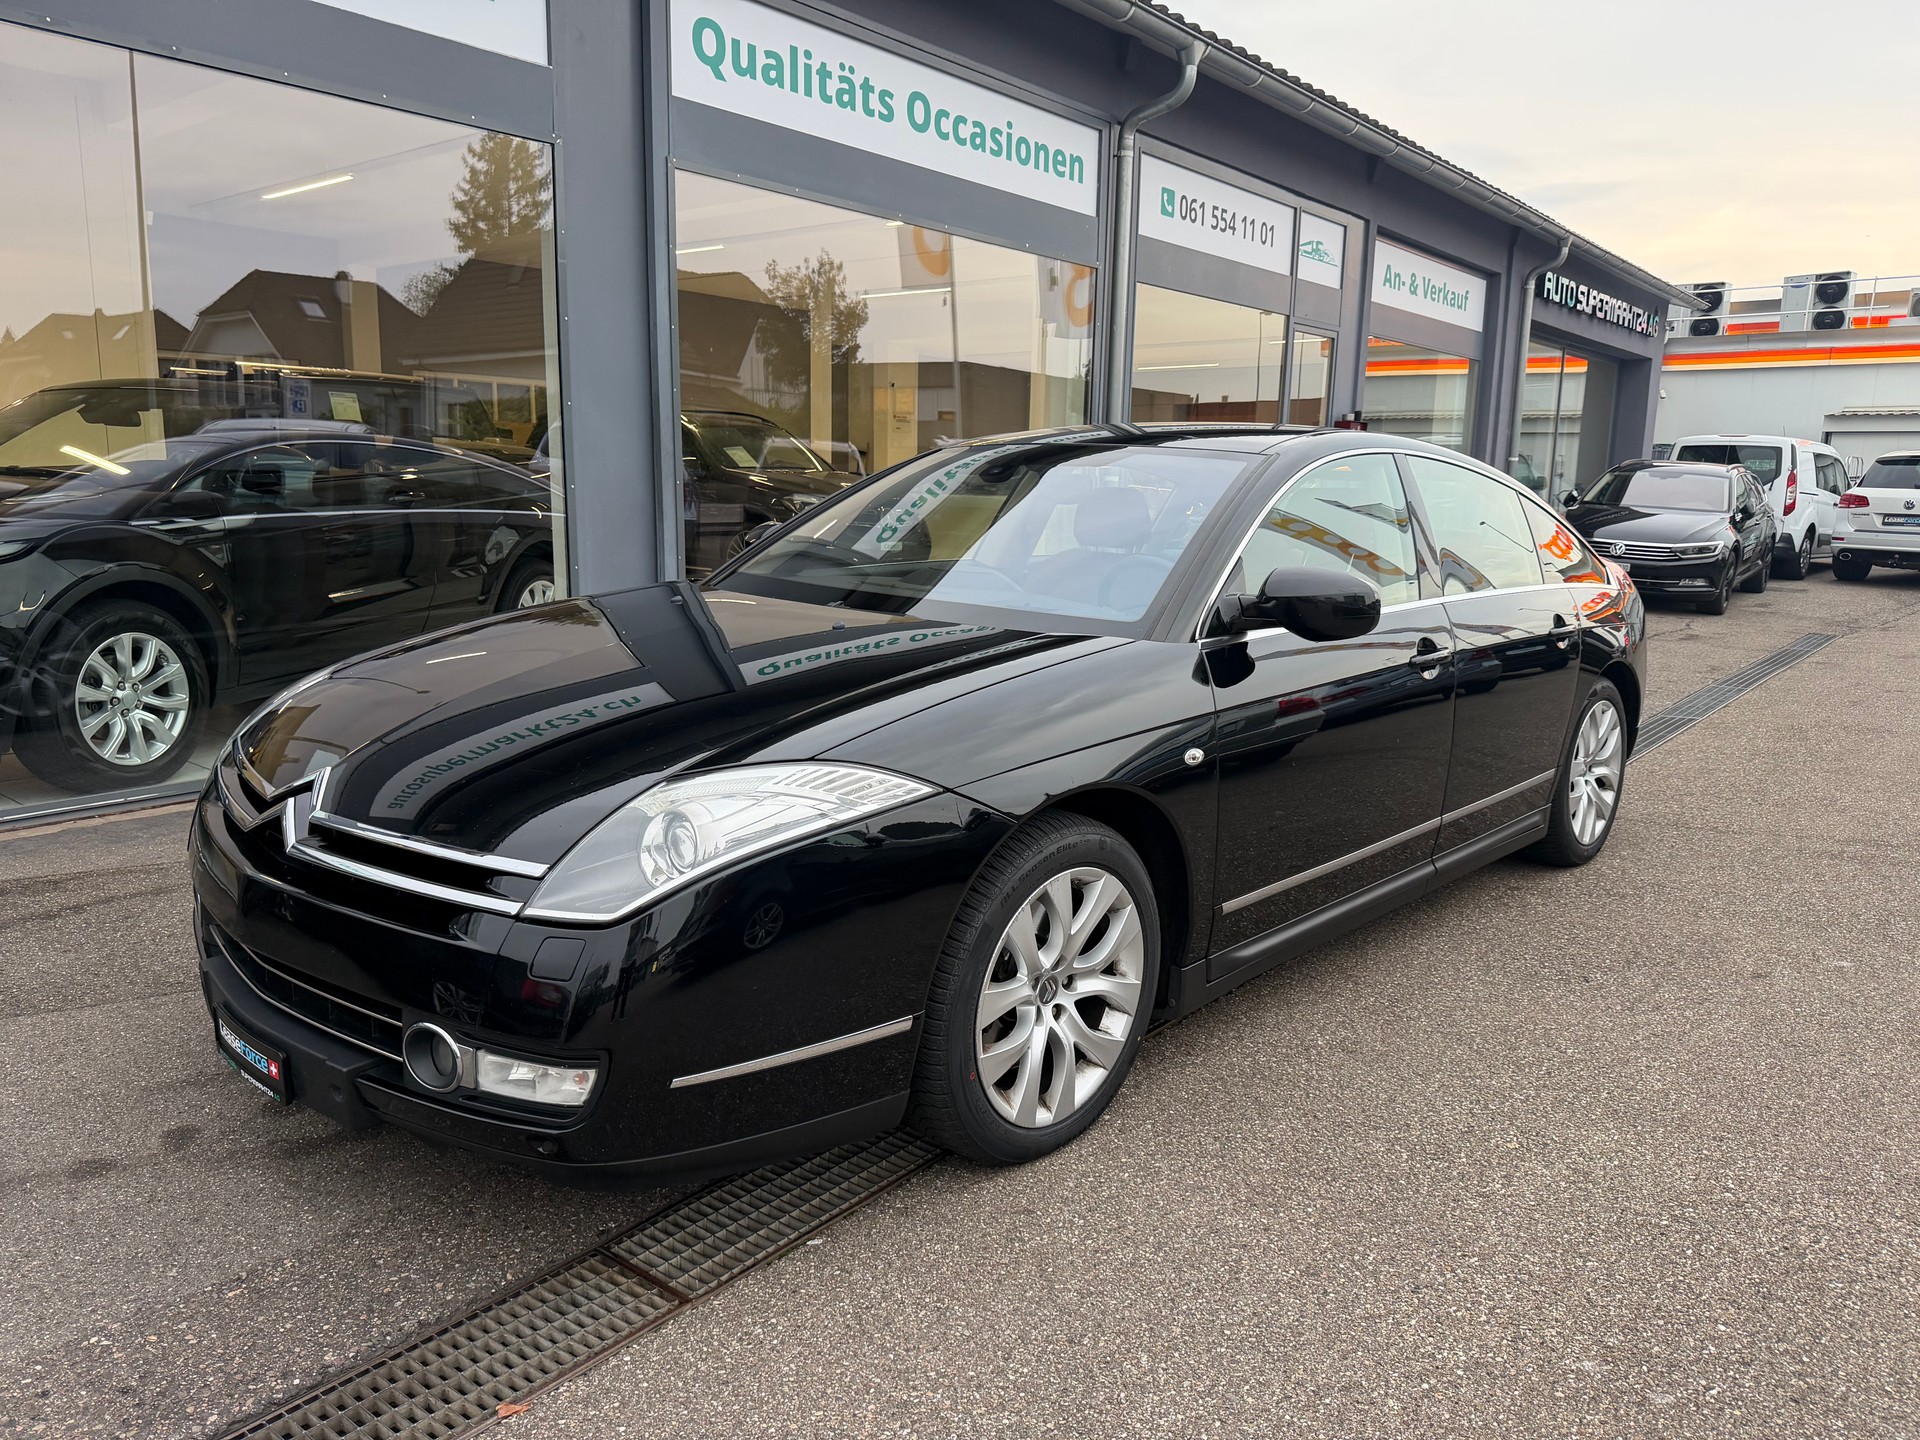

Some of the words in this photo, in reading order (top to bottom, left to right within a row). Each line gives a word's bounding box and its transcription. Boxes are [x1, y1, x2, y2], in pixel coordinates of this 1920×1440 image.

[692, 16, 895, 123] Qualitäts
[907, 90, 1084, 185] Occasionen
[1180, 194, 1205, 227] 061
[1211, 205, 1236, 236] 554
[1241, 215, 1255, 242] 11
[1260, 221, 1275, 248] 01
[1383, 264, 1405, 291] An-
[1409, 272, 1418, 297] &
[1422, 276, 1470, 312] Verkauf
[1543, 271, 1576, 308] AUTO
[1576, 284, 1648, 334] SUPERMARKT24
[1647, 313, 1660, 338] AG
[220, 1019, 269, 1073] LeaseForce
